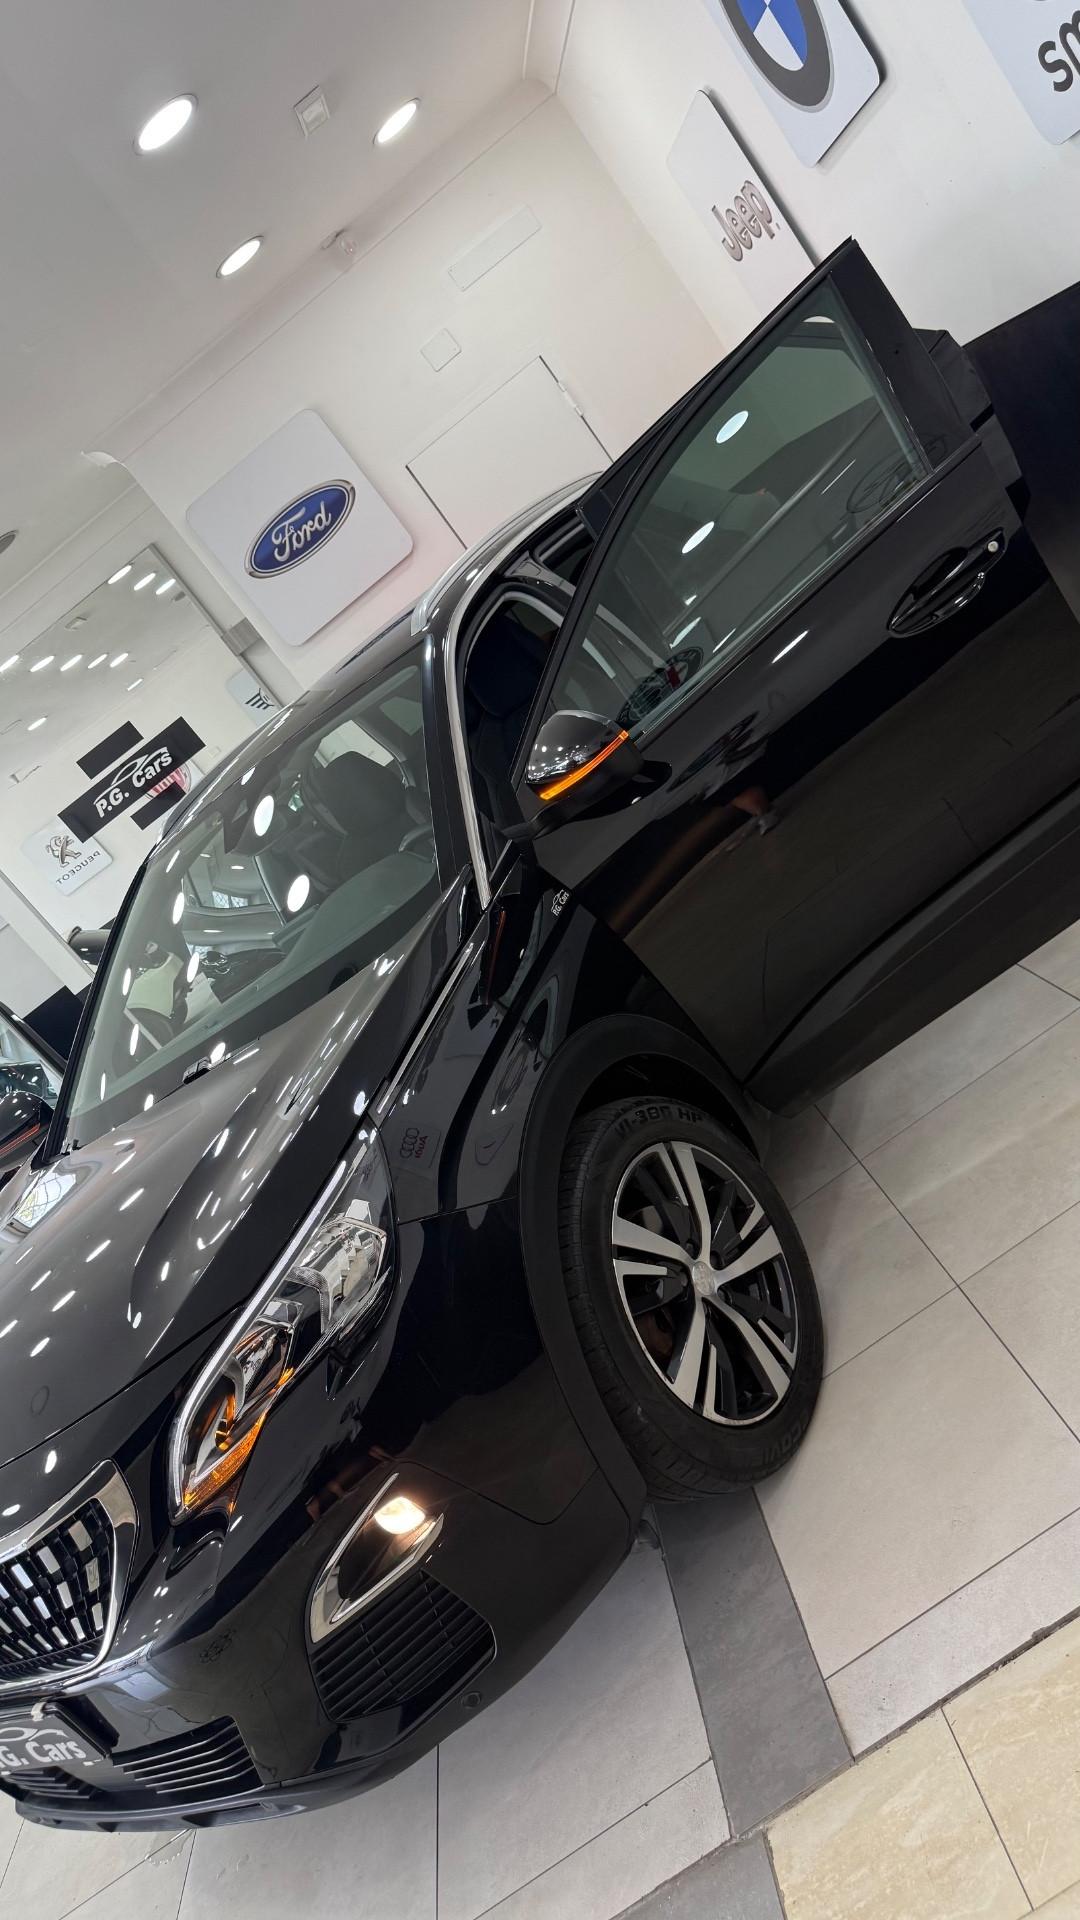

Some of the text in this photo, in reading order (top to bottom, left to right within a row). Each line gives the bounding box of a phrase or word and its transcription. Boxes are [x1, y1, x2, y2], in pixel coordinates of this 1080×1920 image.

[711, 180, 776, 261] Jeep
[272, 500, 332, 561] Ford
[95, 788, 130, 818] P.G.
[131, 749, 173, 788] Cars
[558, 891, 570, 905] Cars
[25, 1740, 86, 1763] Cars
